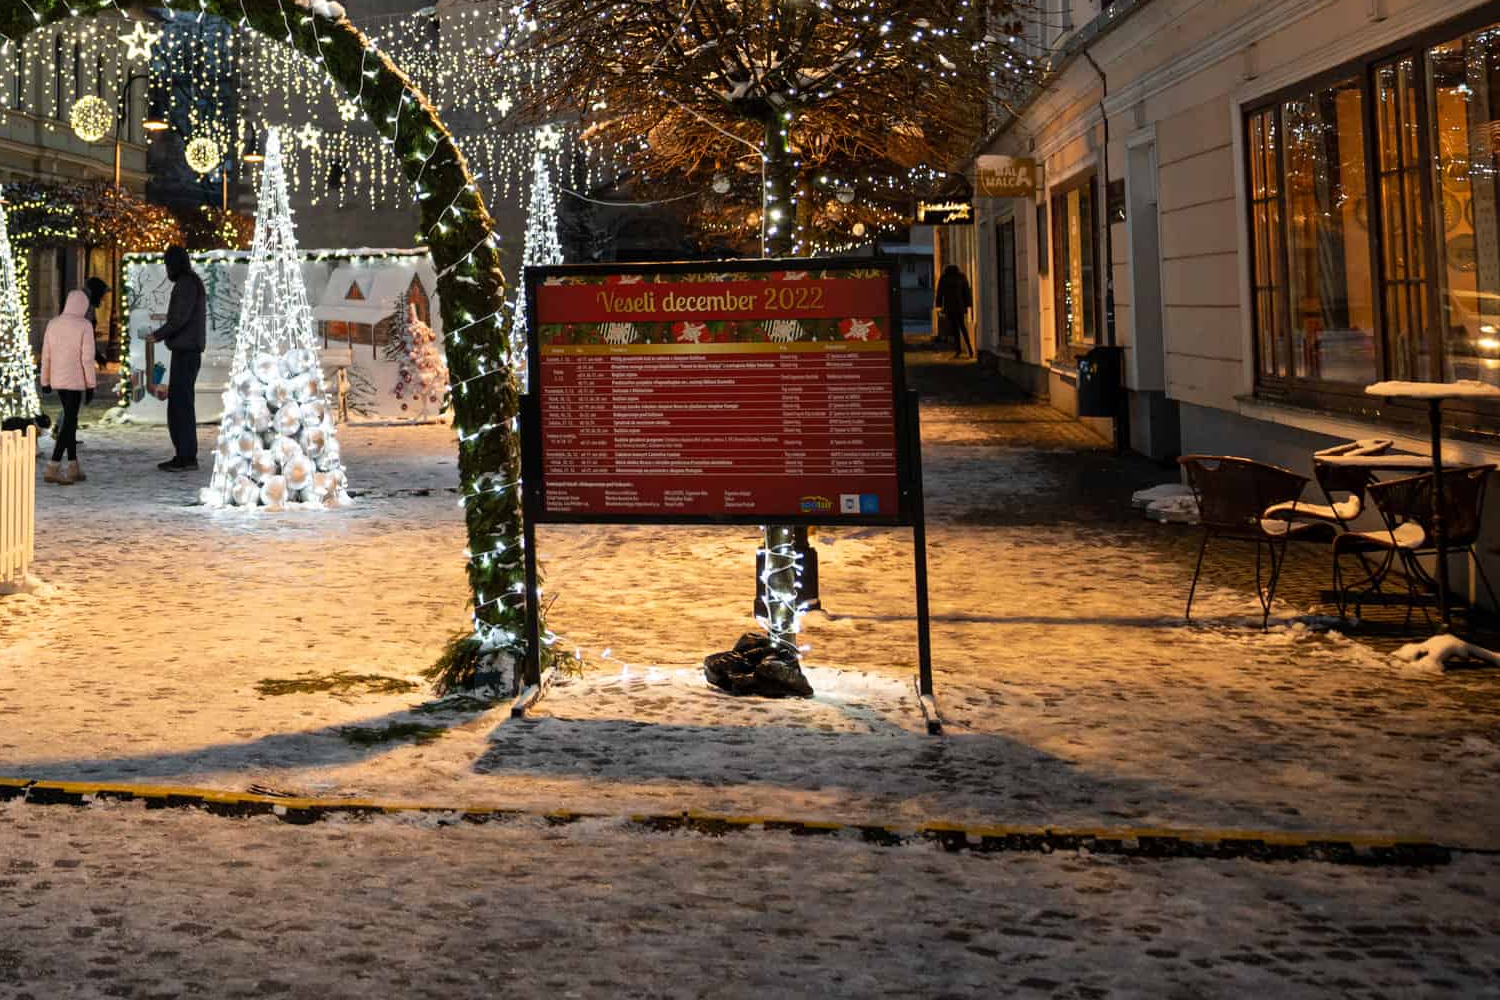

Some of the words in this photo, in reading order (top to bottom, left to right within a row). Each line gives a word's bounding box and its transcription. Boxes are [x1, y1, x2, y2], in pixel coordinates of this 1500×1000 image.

[596, 291, 656, 313] Veseli
[662, 290, 757, 312] december
[763, 287, 824, 310] 2022
